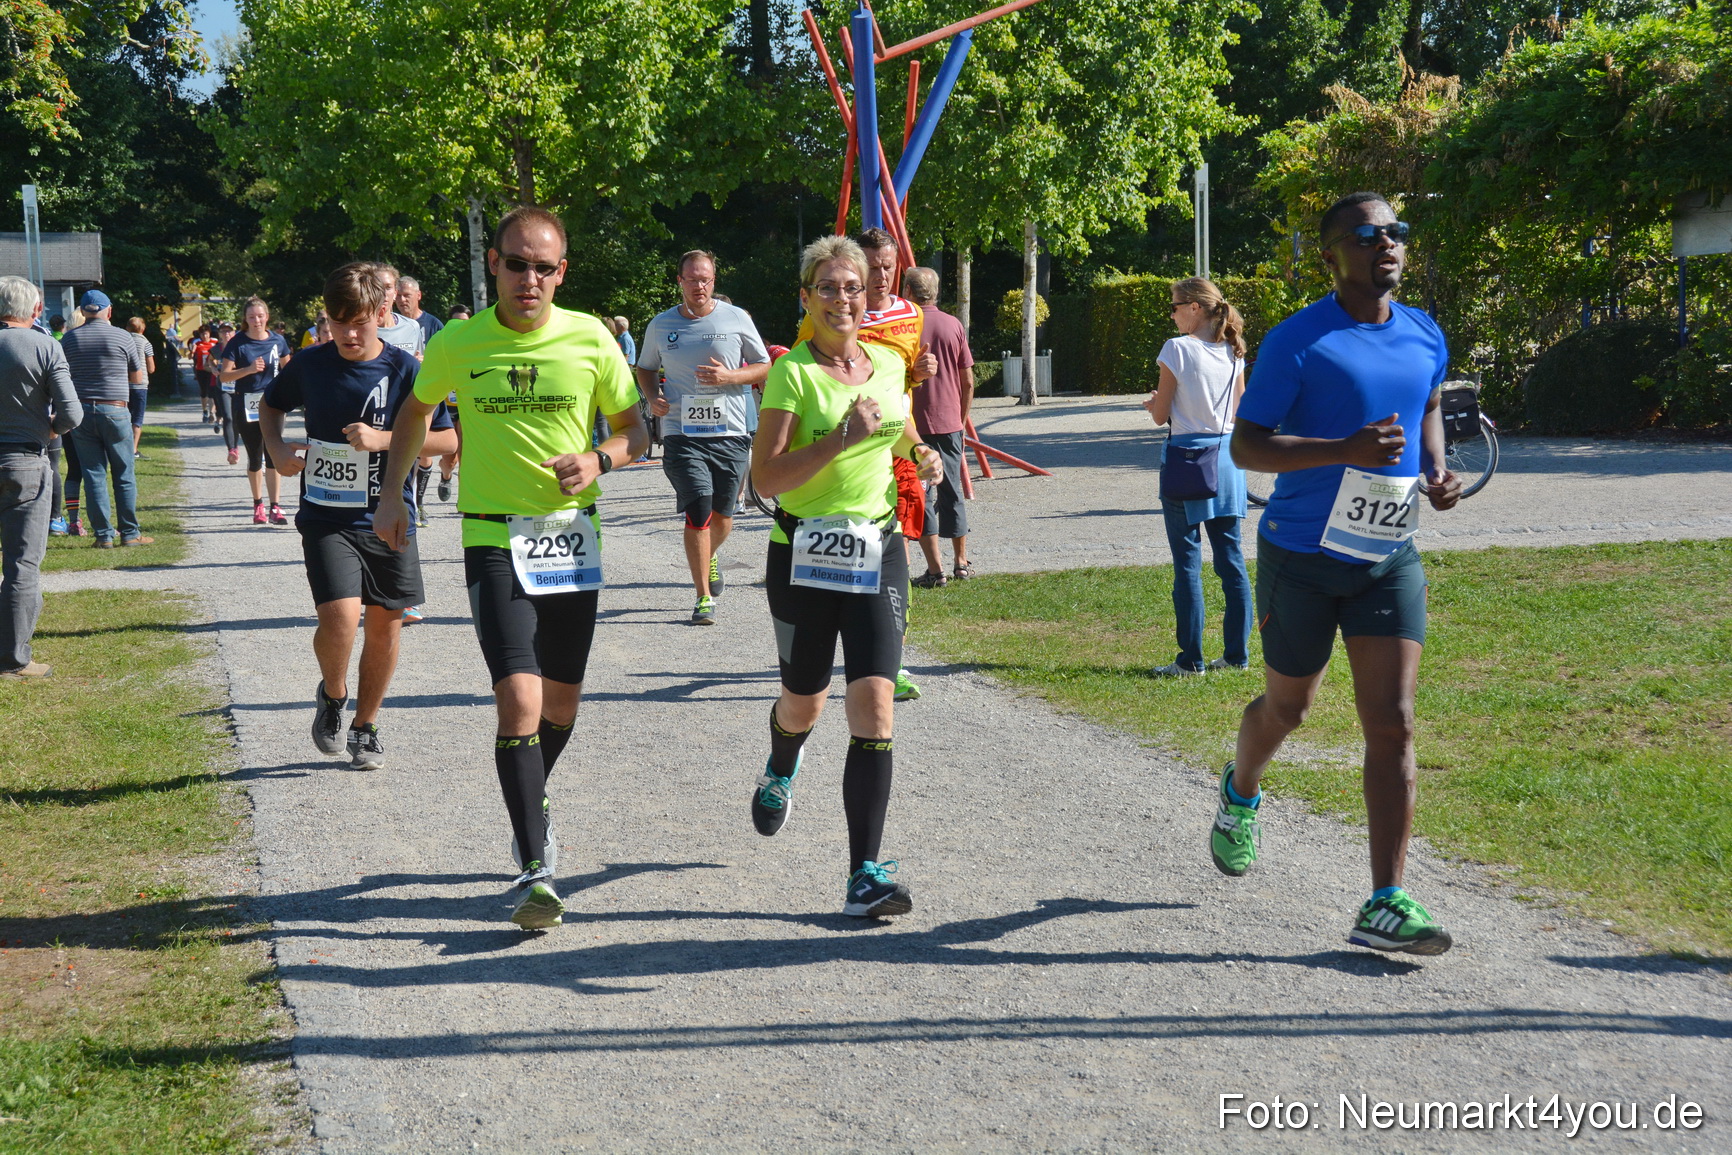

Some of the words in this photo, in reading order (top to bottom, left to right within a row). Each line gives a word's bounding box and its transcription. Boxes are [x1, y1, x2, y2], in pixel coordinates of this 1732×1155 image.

[688, 407, 721, 420] 2315
[322, 447, 348, 457] BOCK
[313, 458, 357, 481] 2385
[1369, 483, 1405, 494] BOCK
[324, 491, 340, 500] Tom
[1347, 497, 1411, 528] 3122
[534, 519, 571, 531] BOCK
[1348, 524, 1368, 533] PARTL
[524, 533, 586, 559] 2292
[807, 532, 866, 558] 2291
[536, 572, 584, 585] Benjamin
[810, 569, 862, 583] Alexandra
